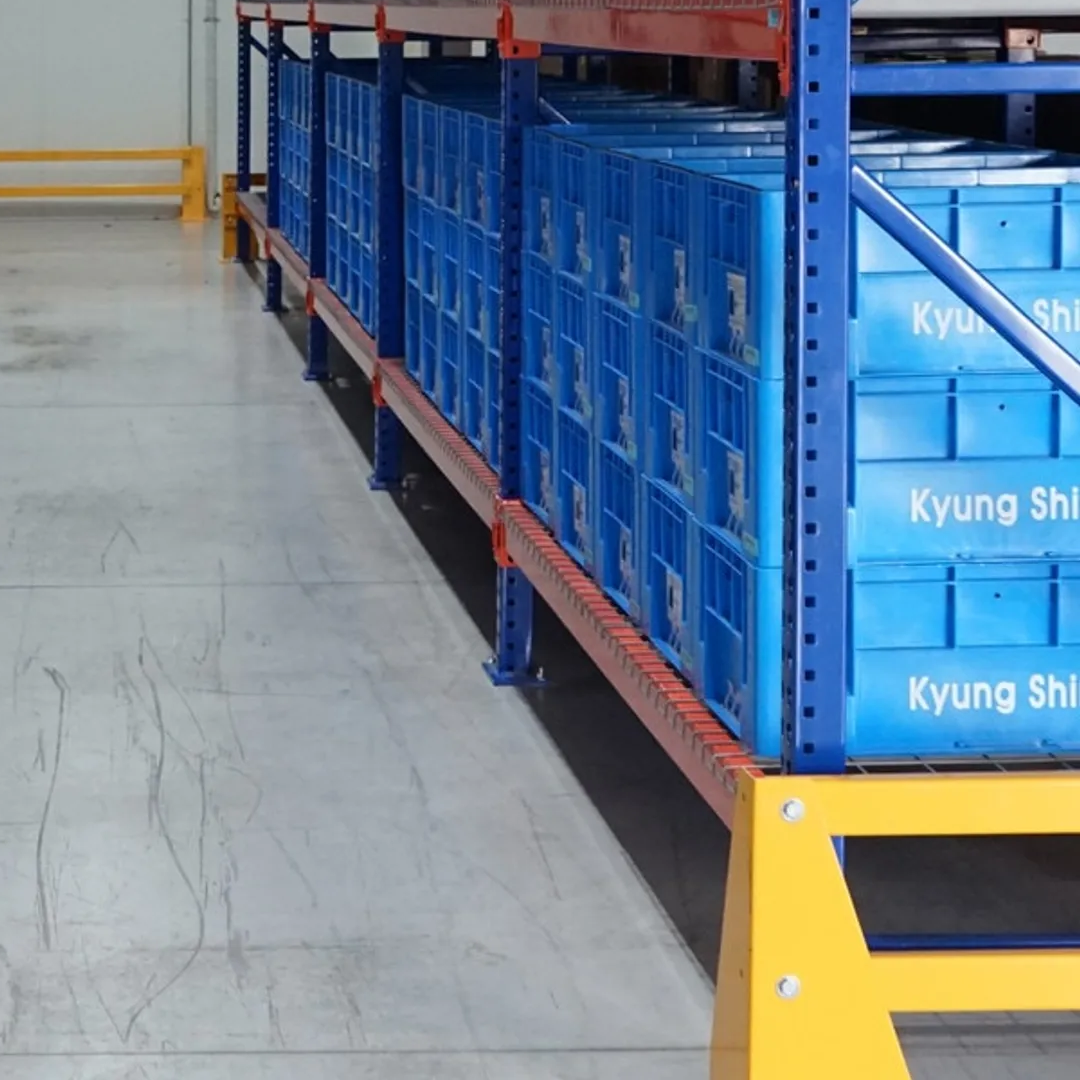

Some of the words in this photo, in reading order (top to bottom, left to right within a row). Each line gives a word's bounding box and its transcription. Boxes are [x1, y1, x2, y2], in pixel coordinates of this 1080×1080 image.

[913, 300, 996, 340] Kyu
[910, 487, 1018, 528] Kyung
[909, 676, 1016, 716] Kyung
[1028, 673, 1080, 709] Shi
